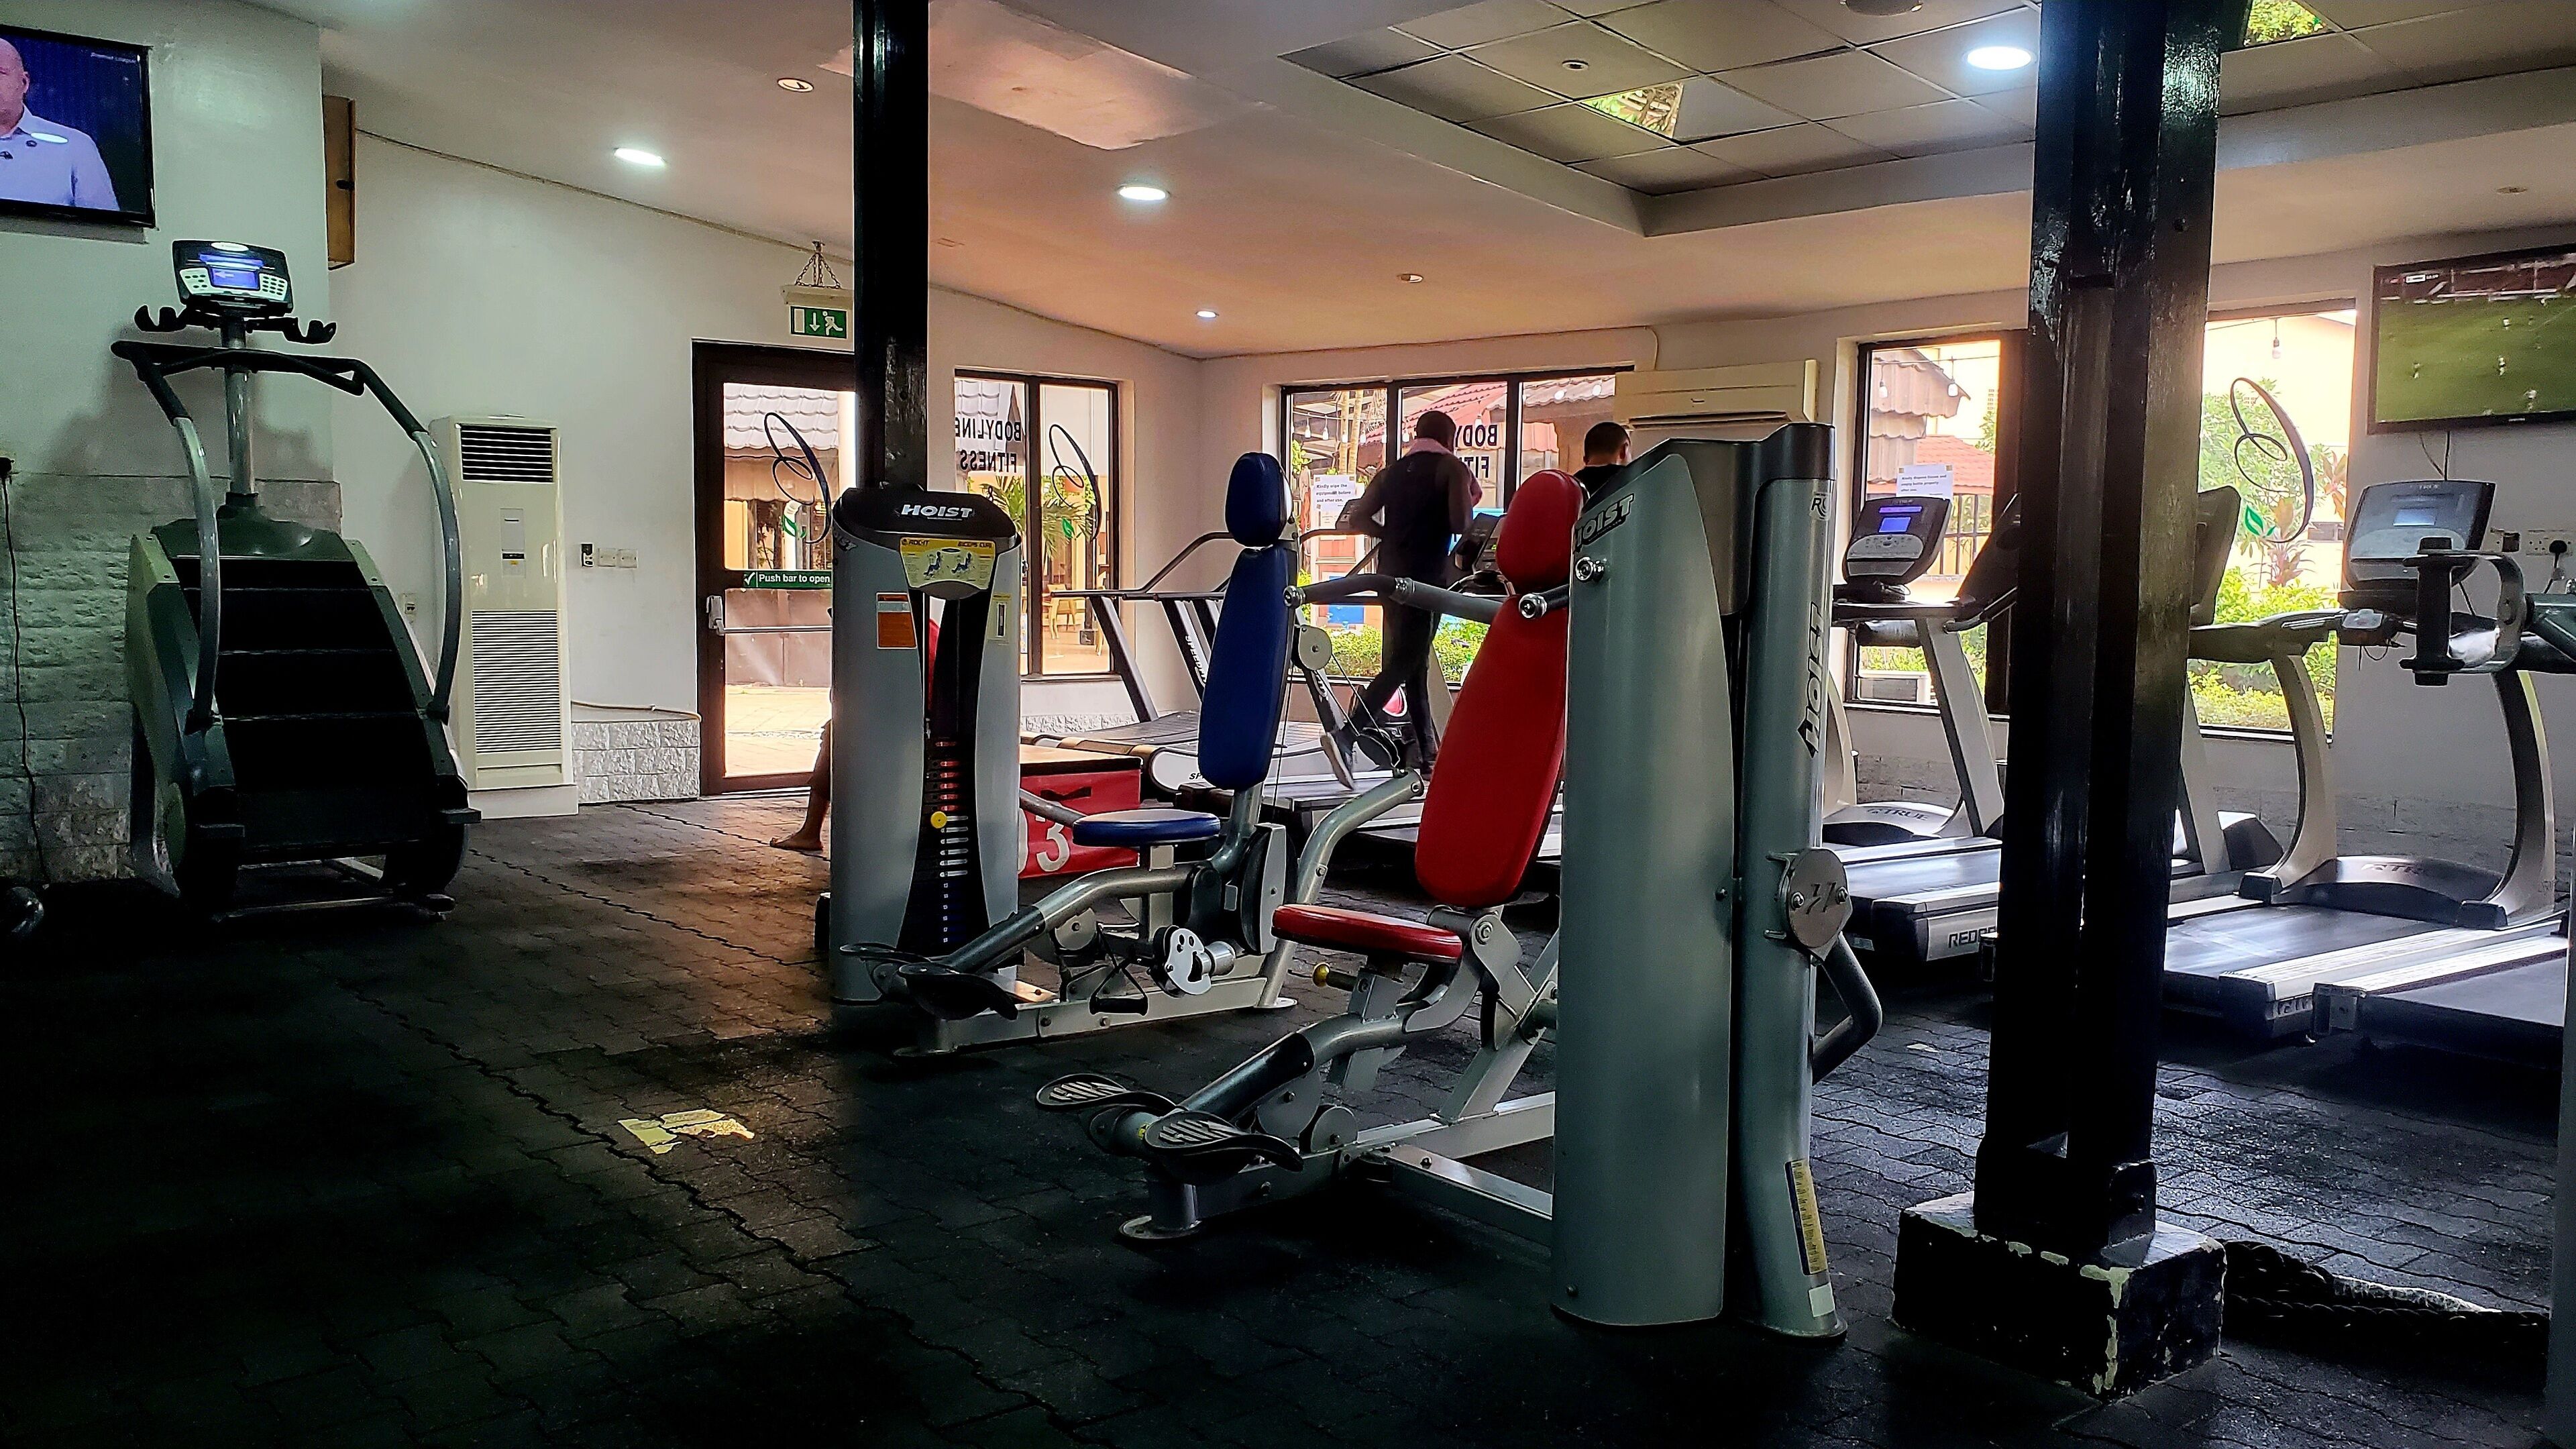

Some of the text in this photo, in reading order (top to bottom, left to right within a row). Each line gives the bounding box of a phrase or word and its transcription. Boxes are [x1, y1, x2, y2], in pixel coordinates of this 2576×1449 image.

[901, 504, 973, 518] HOIST
[759, 574, 830, 584] Push bar to open
[1805, 602, 1824, 753] HOIST
[1882, 809, 1930, 821] TRUE
